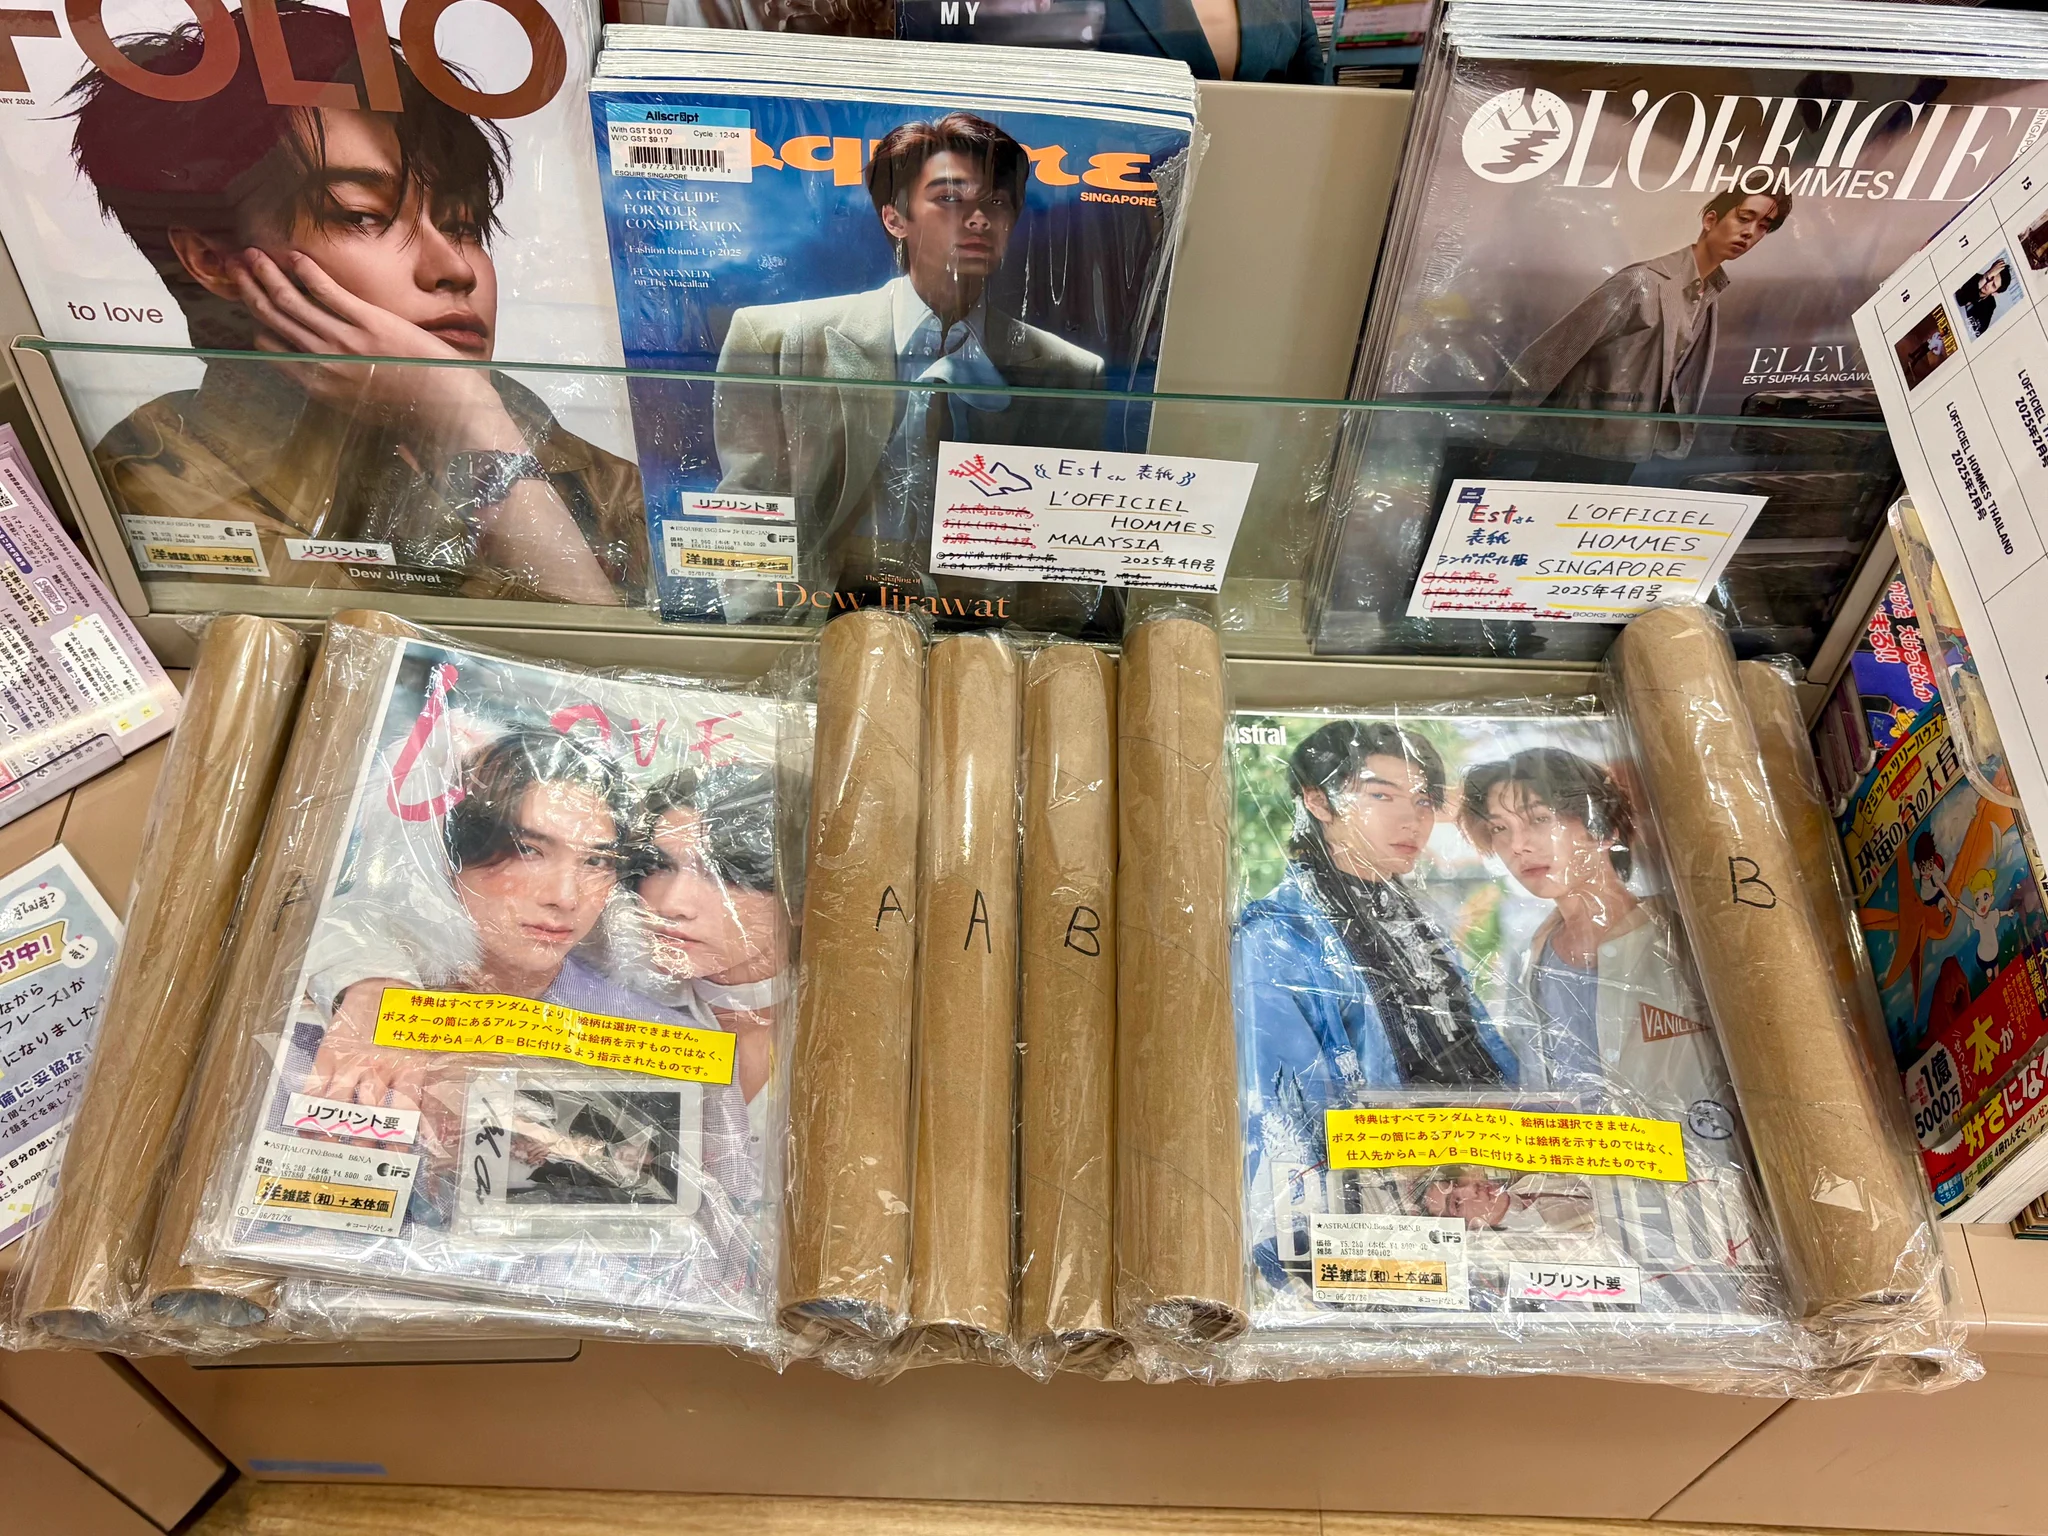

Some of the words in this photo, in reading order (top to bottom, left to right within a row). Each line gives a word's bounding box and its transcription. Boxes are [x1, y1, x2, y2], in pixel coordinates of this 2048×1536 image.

[610, 126, 628, 134] With
[693, 130, 714, 139] Cycle
[630, 135, 646, 143] GST
[647, 171, 688, 180] SINGAPORE
[1709, 165, 1895, 200] HOMMES
[2021, 176, 2033, 191] 15
[622, 189, 632, 200] A
[636, 190, 674, 201] GIFT
[674, 191, 720, 203] GUIDE
[1080, 192, 1157, 208] SINGAPORE
[624, 204, 654, 215] FOR
[656, 204, 697, 217] YOUR
[625, 218, 742, 233] CONSIDERATION
[1958, 234, 1969, 248] 17
[629, 244, 666, 255] Fashion
[717, 248, 742, 257] 2025
[634, 278, 647, 287] on
[649, 277, 667, 287] The
[669, 279, 709, 288] Macallan
[663, 269, 711, 279] KENNEDY
[1900, 288, 1911, 303] 18
[66, 301, 97, 324] to
[103, 301, 165, 325] love
[1742, 375, 1767, 385] EST
[1768, 373, 1810, 384] SUPHA
[2017, 368, 2047, 424] L'OFFICIEL
[1136, 464, 1175, 482] 表紙
[1946, 401, 1972, 455] L'OFFICIEL
[1966, 454, 1992, 501] HOMMES
[1987, 500, 2014, 556] THAILAND
[1951, 449, 1988, 521] 2025年2月号
[699, 498, 780, 514] リプリント要
[1049, 490, 1189, 513] L'OFFICIEL
[1567, 503, 1715, 526] L'OFFICIEL
[1110, 516, 1215, 535] HOMMES
[1047, 533, 1160, 551] MALAYSIA
[1466, 529, 1512, 546] 表紙
[1576, 534, 1701, 553] HOMMES
[1120, 555, 1216, 572] 2025年4月号
[1535, 559, 1686, 578] SINGAPORE
[349, 567, 384, 580] Dew
[386, 569, 442, 584] Jirawat
[864, 574, 880, 582] The
[879, 575, 911, 587] shaping
[911, 576, 922, 585] of
[775, 582, 866, 610] Dew
[879, 585, 1011, 619] Jirawat
[1546, 583, 1663, 603] 2025年4月号
[1864, 721, 1941, 816] マジック・ツリーハウス
[1727, 855, 1778, 910] B
[875, 884, 909, 934] A
[963, 888, 993, 955] A
[1064, 904, 1102, 960] B
[1965, 1014, 2000, 1076] 本
[1999, 1020, 2015, 1054] が
[307, 1104, 401, 1130] リプリント要
[1354, 1112, 1648, 1135] 特典はすべてランダムとなり、絵柄は選択できません。
[1331, 1131, 1674, 1156] ポスターの筒にあるアルファベットは絵柄を示すものではなく、
[256, 1156, 273, 1166] 価格
[254, 1165, 271, 1175] 雑誌
[1316, 1239, 1332, 1248] 価格
[1316, 1247, 1333, 1256] 雑誌
[1529, 1271, 1622, 1292] リプリント要
